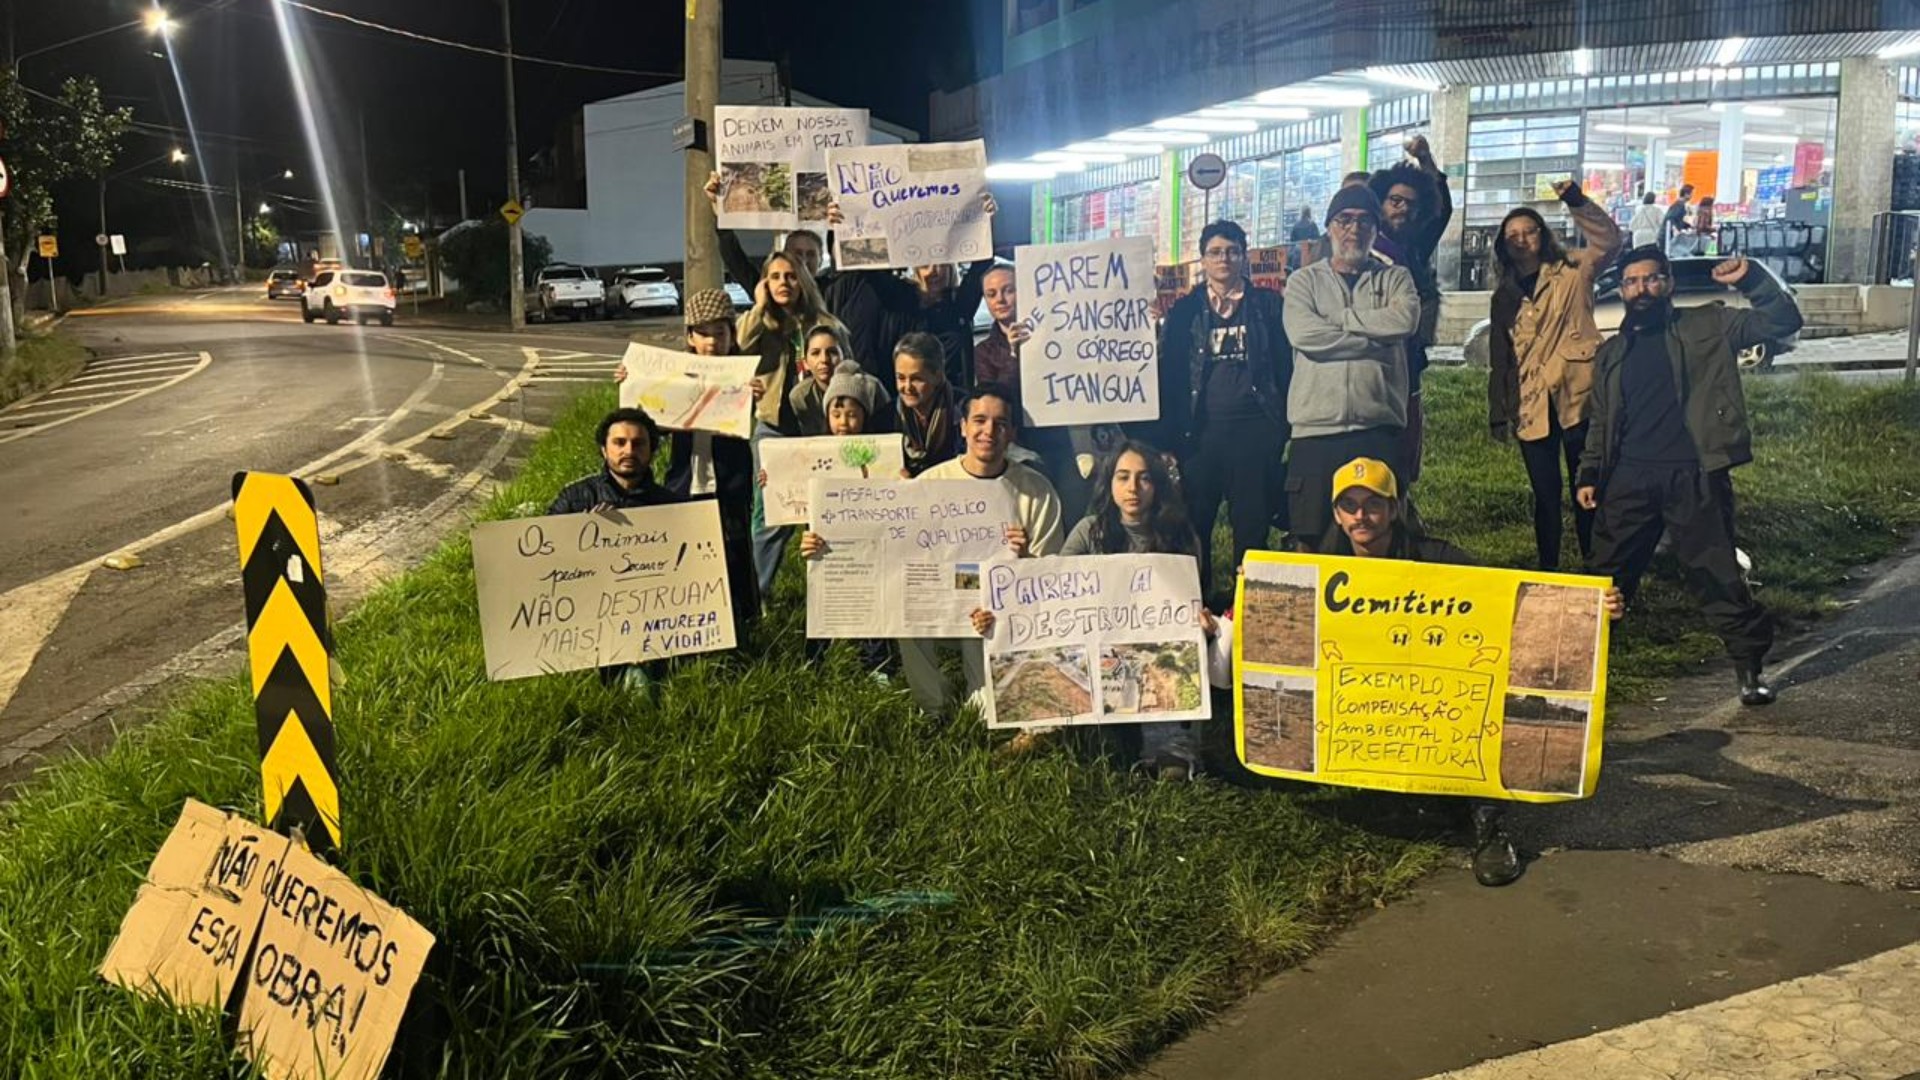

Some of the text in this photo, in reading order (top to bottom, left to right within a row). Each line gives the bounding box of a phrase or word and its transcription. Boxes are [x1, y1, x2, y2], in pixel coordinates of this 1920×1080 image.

[723, 115, 848, 138] DEIXEM NOSSOS
[721, 141, 776, 157] ANIMAIS
[785, 136, 801, 148] EM
[872, 183, 961, 208] Queremos
[1034, 252, 1129, 297] PAREM
[1026, 298, 1150, 333] DE SANGRAR
[1044, 334, 1154, 364] O CÓRREGO
[1043, 362, 1147, 405] ITANGUÁ
[838, 506, 919, 523] TRANSPORTE
[518, 520, 668, 558] Os Animais
[889, 526, 906, 540] DE
[990, 564, 1101, 611] PAREM
[1130, 565, 1153, 593] A
[1324, 571, 1473, 617] Cemitério
[510, 577, 728, 631] NÃO DESTRUAM
[620, 620, 631, 636] A
[643, 610, 717, 633] NATUREZA
[642, 635, 651, 653] É
[1339, 667, 1487, 702] EXEMPLO DE
[1335, 721, 1482, 744] AMBIENTAL DA
[1332, 738, 1478, 768] PREFEITURA
[204, 835, 398, 986] NÃO QUEREMOS
[188, 906, 241, 971] ESSA
